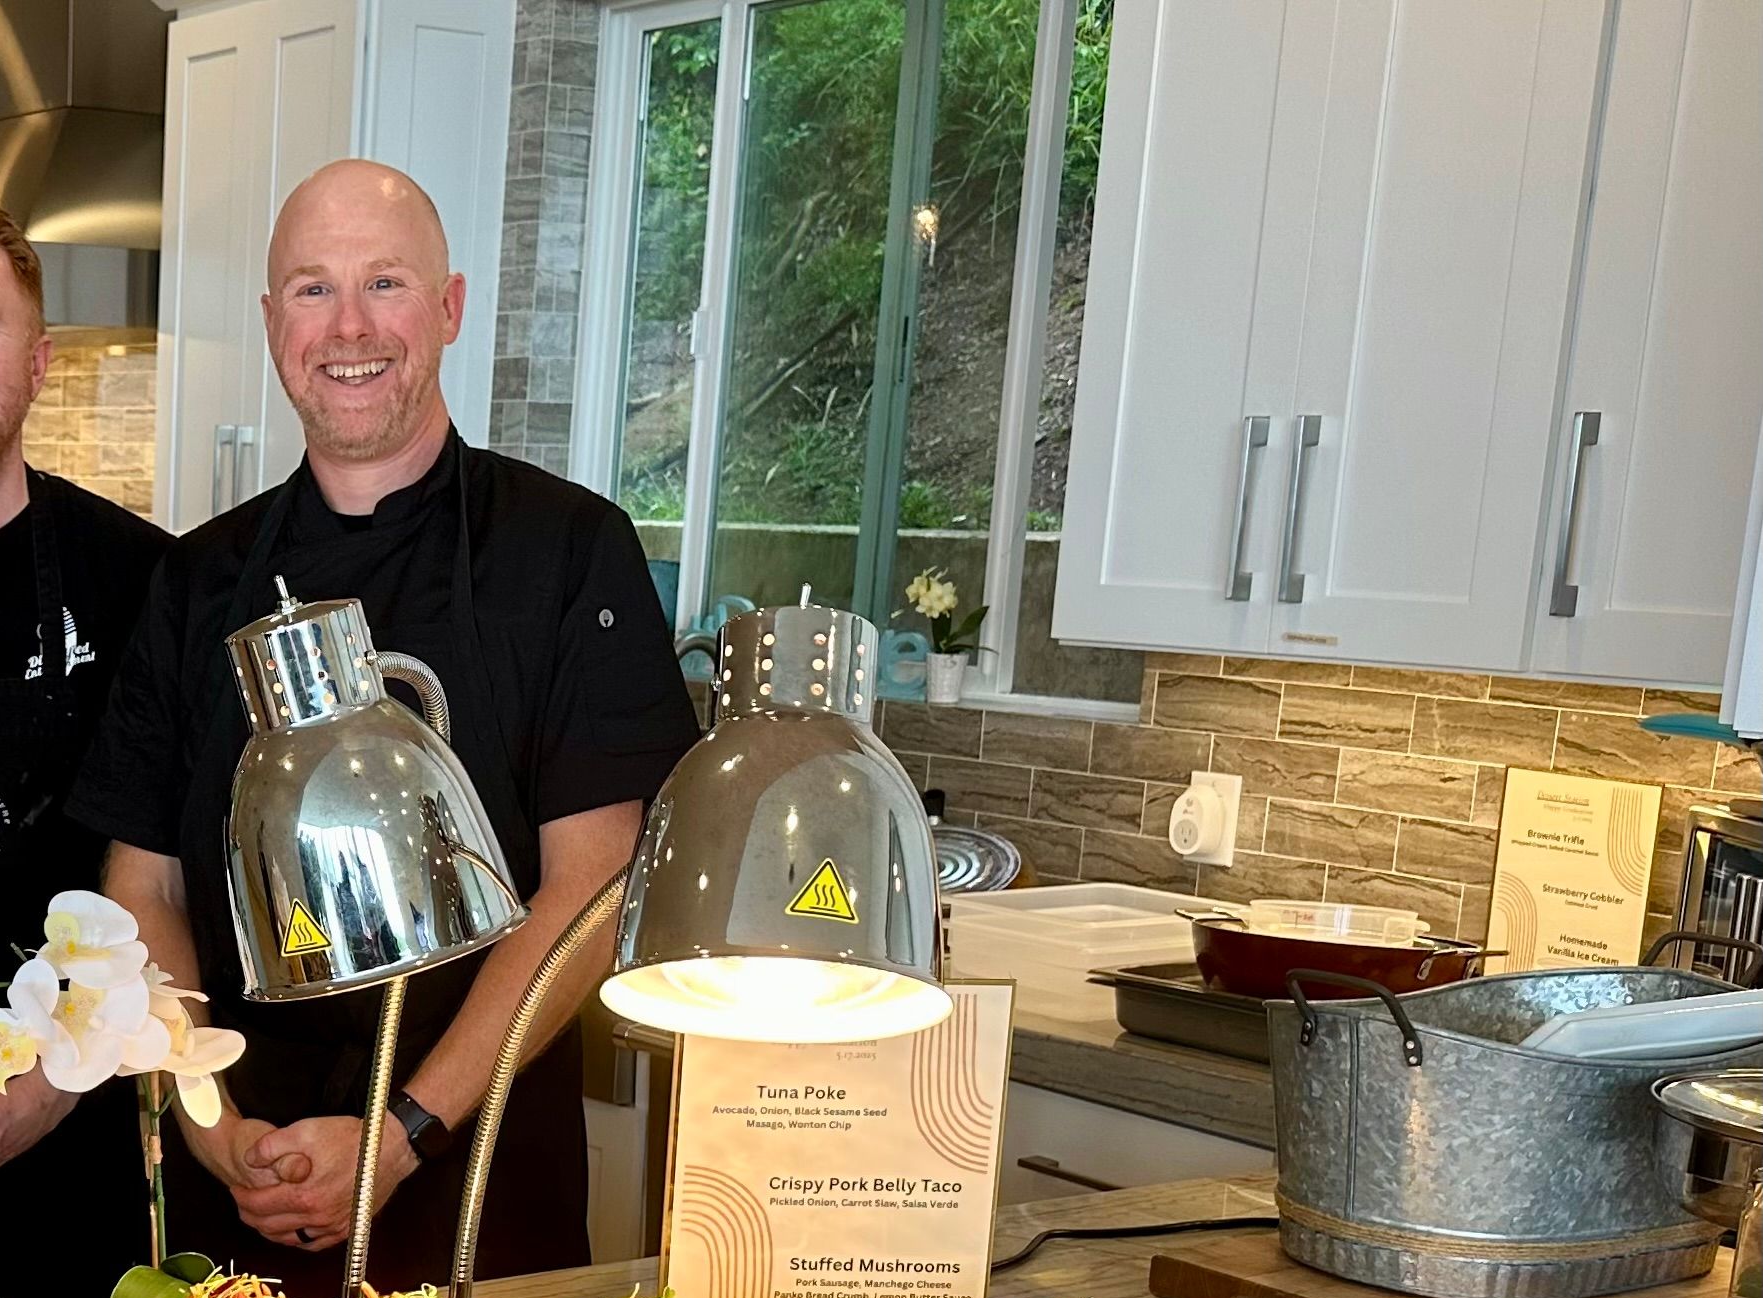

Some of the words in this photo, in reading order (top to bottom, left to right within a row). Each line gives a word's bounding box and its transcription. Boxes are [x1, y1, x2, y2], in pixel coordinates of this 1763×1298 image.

[1527, 829, 1561, 842] Brownie
[1563, 834, 1585, 845] Trifle
[1542, 883, 1589, 900] Strawberry
[1590, 891, 1625, 905] Cobbler
[1559, 933, 1608, 950] Homemade
[1547, 945, 1575, 958] Vanilla
[1577, 950, 1590, 961] Ice
[1591, 953, 1620, 966] Cream
[756, 1085, 799, 1099] Tuna
[804, 1086, 846, 1100] Poke
[712, 1106, 758, 1116] Avocado,
[760, 1107, 792, 1116] Onion,
[794, 1107, 821, 1116] Black
[823, 1108, 860, 1116] Sesame
[863, 1108, 887, 1117] Seed
[746, 1120, 786, 1130] Masago,
[788, 1120, 827, 1129] Wonton
[829, 1120, 852, 1131] Chip
[769, 1176, 824, 1194] Crispy
[829, 1177, 868, 1192] Pork
[873, 1178, 916, 1196] Belly
[920, 1179, 962, 1193] Taco
[769, 1197, 804, 1206] Pickled
[807, 1198, 838, 1208] Onion,
[841, 1199, 872, 1207] Carrot
[875, 1199, 900, 1209] Slaw,
[902, 1200, 928, 1208] Salsa
[930, 1200, 959, 1209] Verde
[790, 1257, 854, 1272] Stuffed
[859, 1258, 961, 1274] Mushrooms
[795, 1279, 818, 1287] Pork
[820, 1279, 862, 1289] Sausage,
[864, 1280, 914, 1290] Manchego
[916, 1280, 952, 1289] Cheese
[774, 1291, 804, 1298] Panko
